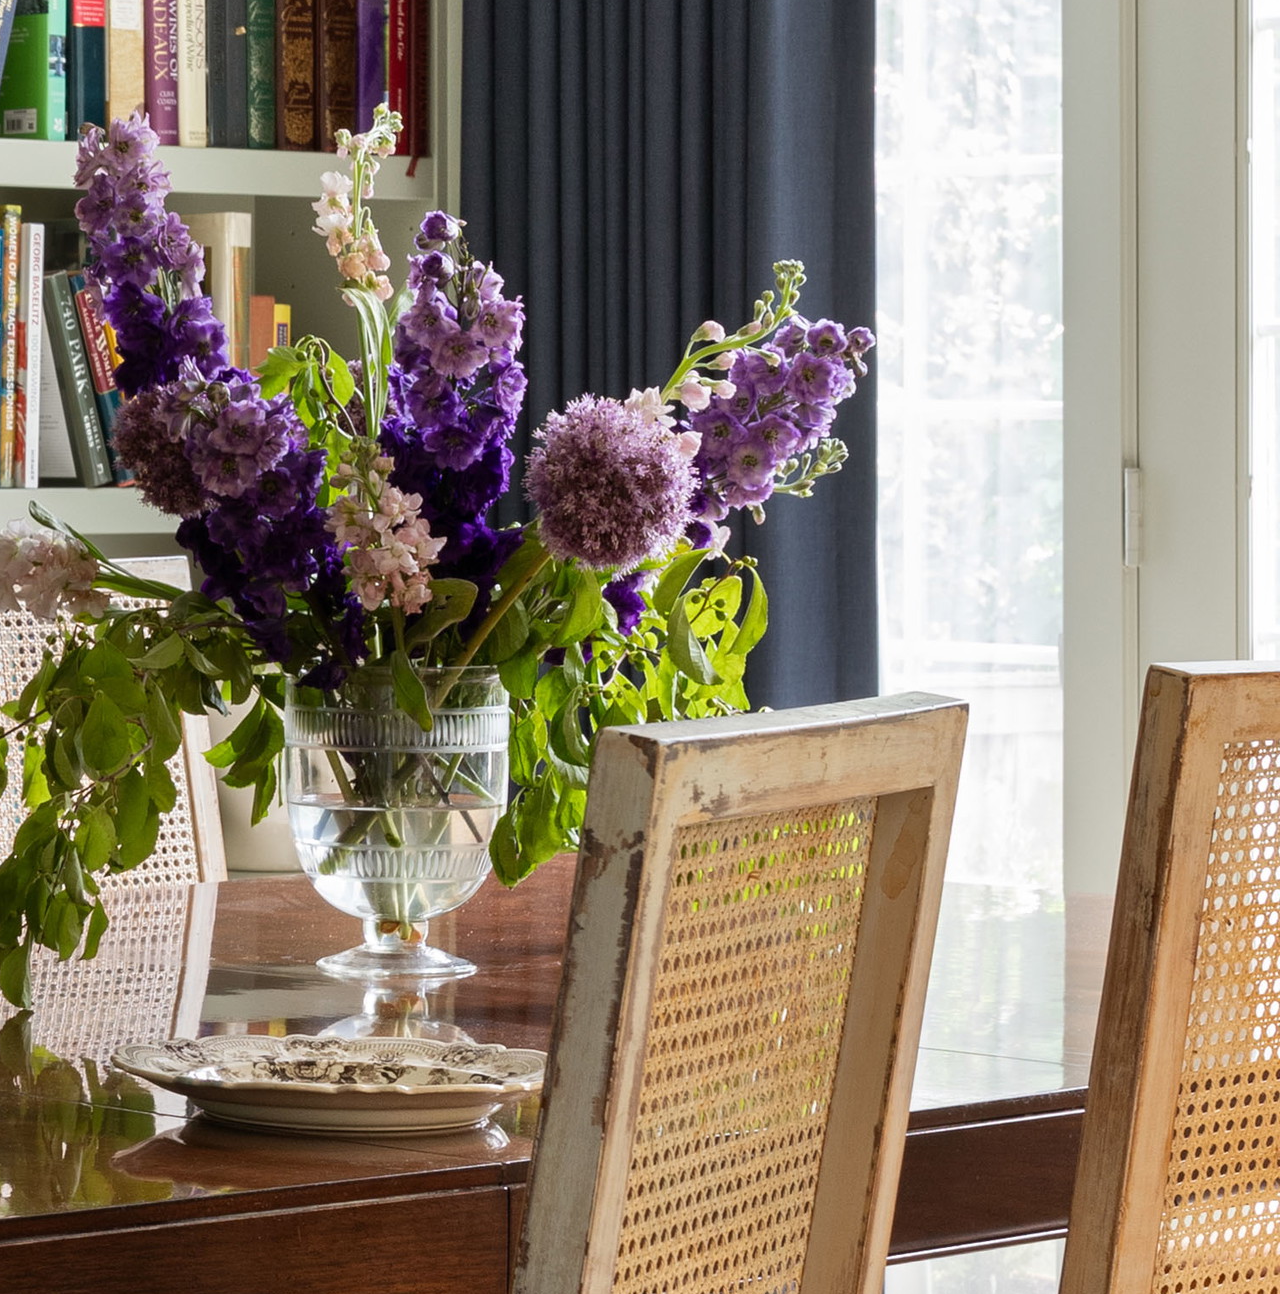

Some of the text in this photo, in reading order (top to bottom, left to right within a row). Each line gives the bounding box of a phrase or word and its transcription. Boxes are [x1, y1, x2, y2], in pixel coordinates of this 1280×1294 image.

[168, 0, 178, 52] WINES
[169, 57, 179, 80] OF
[4, 214, 18, 432] WOMEN OF ABSTRACT EXPRESSIONISM
